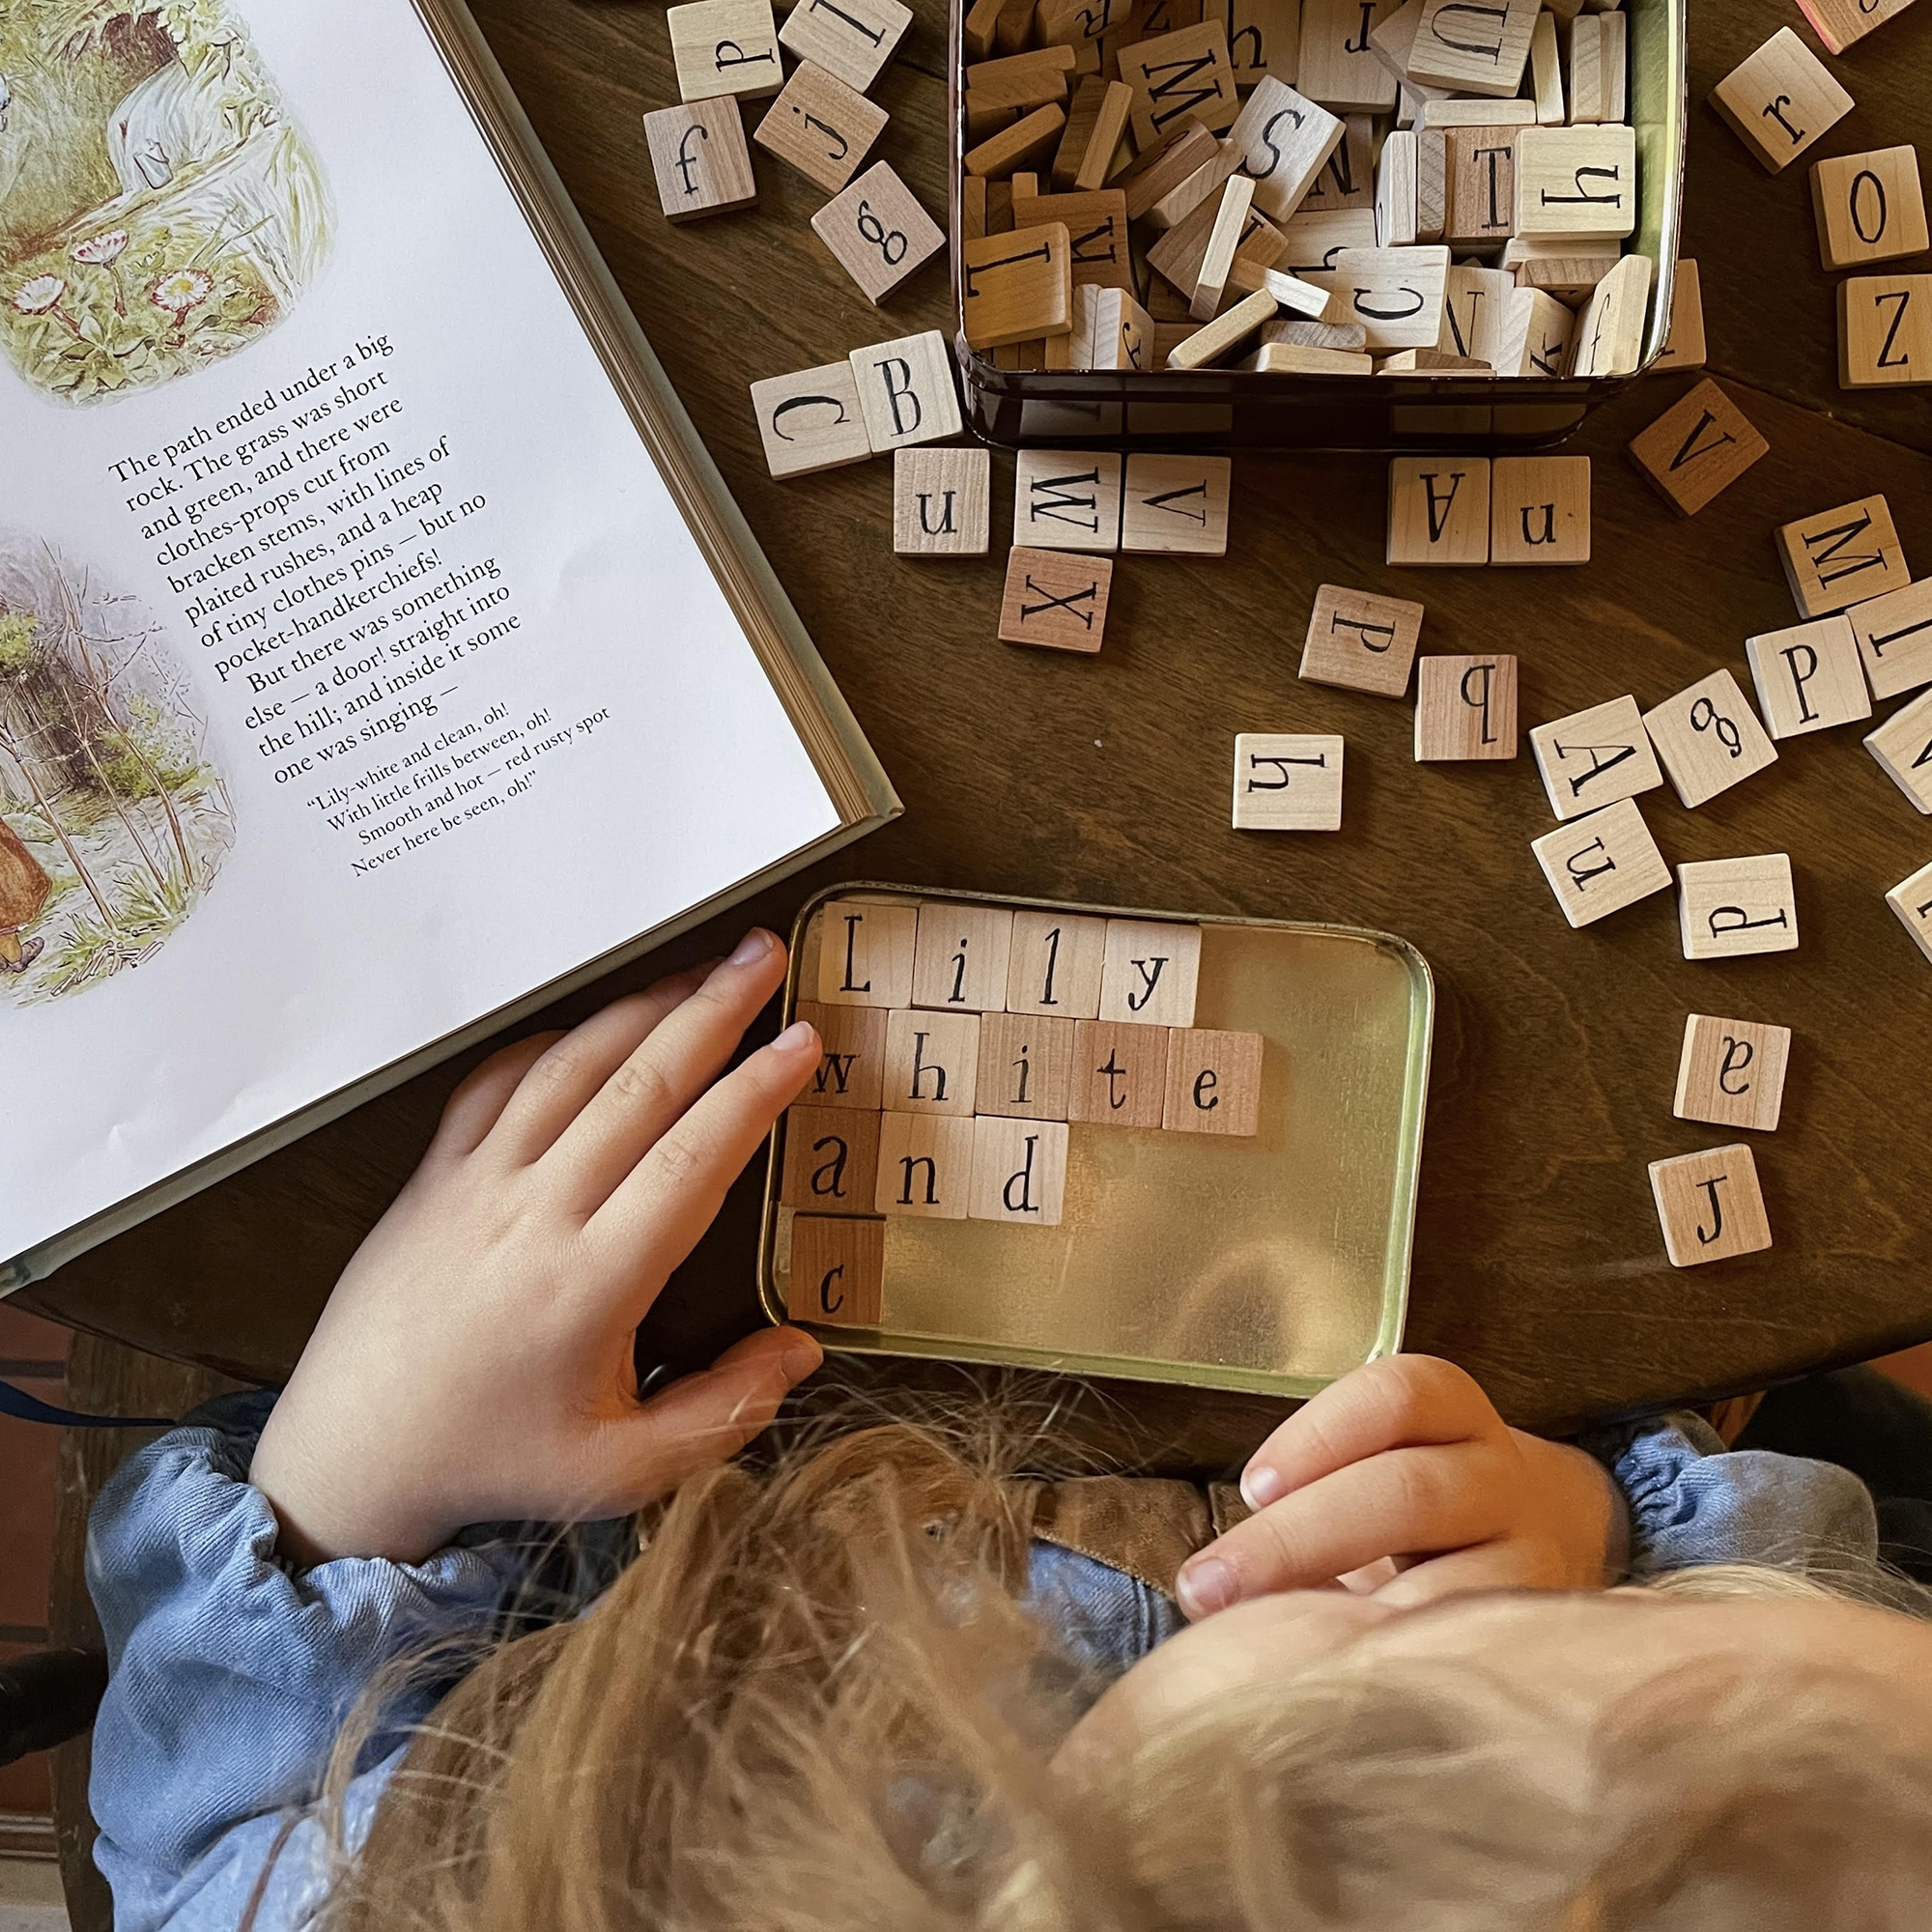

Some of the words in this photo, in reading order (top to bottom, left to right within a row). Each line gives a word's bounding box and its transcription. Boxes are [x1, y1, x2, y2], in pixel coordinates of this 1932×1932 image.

[674, 124, 709, 195] f
[791, 105, 849, 160] j
[1762, 95, 1805, 145] r
[1874, 291, 1911, 368] Z
[107, 453, 161, 483] The
[162, 425, 213, 468] path
[215, 389, 278, 435] ended
[279, 362, 339, 402] under
[342, 355, 357, 370] a
[355, 334, 394, 360] big
[872, 356, 923, 438] B
[1668, 409, 1737, 472] V
[126, 476, 184, 513] rock.
[183, 453, 233, 482] The
[235, 424, 290, 467] grass
[291, 402, 332, 430] was
[333, 371, 389, 410] short
[140, 505, 183, 540] and
[185, 482, 253, 526] green,
[254, 450, 295, 485] and
[296, 428, 352, 464] there
[352, 399, 404, 433] were
[156, 488, 300, 566] clothes-props
[303, 469, 339, 495] cut
[338, 441, 391, 477] from
[166, 545, 257, 594] bracken
[258, 514, 326, 552] stems,
[326, 481, 376, 516] with
[373, 457, 426, 492] lines
[428, 434, 450, 463] of
[1419, 471, 1466, 543] A
[185, 572, 259, 629] plaited
[260, 543, 336, 586] rushes,
[336, 512, 377, 547] and
[378, 510, 393, 526] a
[390, 483, 442, 517] heap
[201, 620, 224, 648] of
[226, 606, 268, 636] tiny
[272, 567, 348, 612] clothes
[350, 543, 394, 582] pins
[417, 509, 458, 537] but
[458, 495, 486, 518] no
[213, 548, 442, 683] pocket-handkerchiefs!
[245, 666, 290, 695] But
[290, 638, 347, 672] there
[348, 615, 389, 642] was
[391, 557, 501, 622] something
[1020, 575, 1097, 631] X
[244, 702, 286, 729] else
[315, 681, 330, 696] a
[332, 645, 387, 687] door!
[388, 608, 469, 658] straight
[466, 586, 510, 616] into
[258, 732, 296, 757] the
[294, 705, 343, 739] hill;
[344, 681, 384, 716] and
[383, 654, 446, 695] inside
[444, 642, 466, 662] it
[467, 615, 522, 652] some
[1778, 643, 1820, 725] P
[274, 756, 314, 784] one
[315, 734, 357, 762] was
[359, 695, 439, 742] singing
[326, 803, 372, 831] With
[370, 784, 412, 811] little
[412, 763, 452, 790] frills
[450, 729, 526, 770] between,
[526, 707, 552, 731] oh!
[357, 805, 424, 846] Smooth
[424, 785, 455, 812] and
[453, 775, 485, 796] hot
[504, 745, 532, 771] red
[532, 727, 573, 755] rusty
[575, 708, 611, 735] spot
[401, 741, 433, 768] and
[434, 724, 482, 751] clean,
[483, 701, 509, 725] oh!
[1553, 738, 1637, 798] A
[350, 845, 401, 878] Never
[401, 826, 440, 851] here
[440, 814, 463, 832] be
[463, 795, 506, 820] seen,
[838, 915, 1170, 1011] Lily
[810, 1134, 1040, 1213] and
[1695, 1175, 1728, 1246] J
